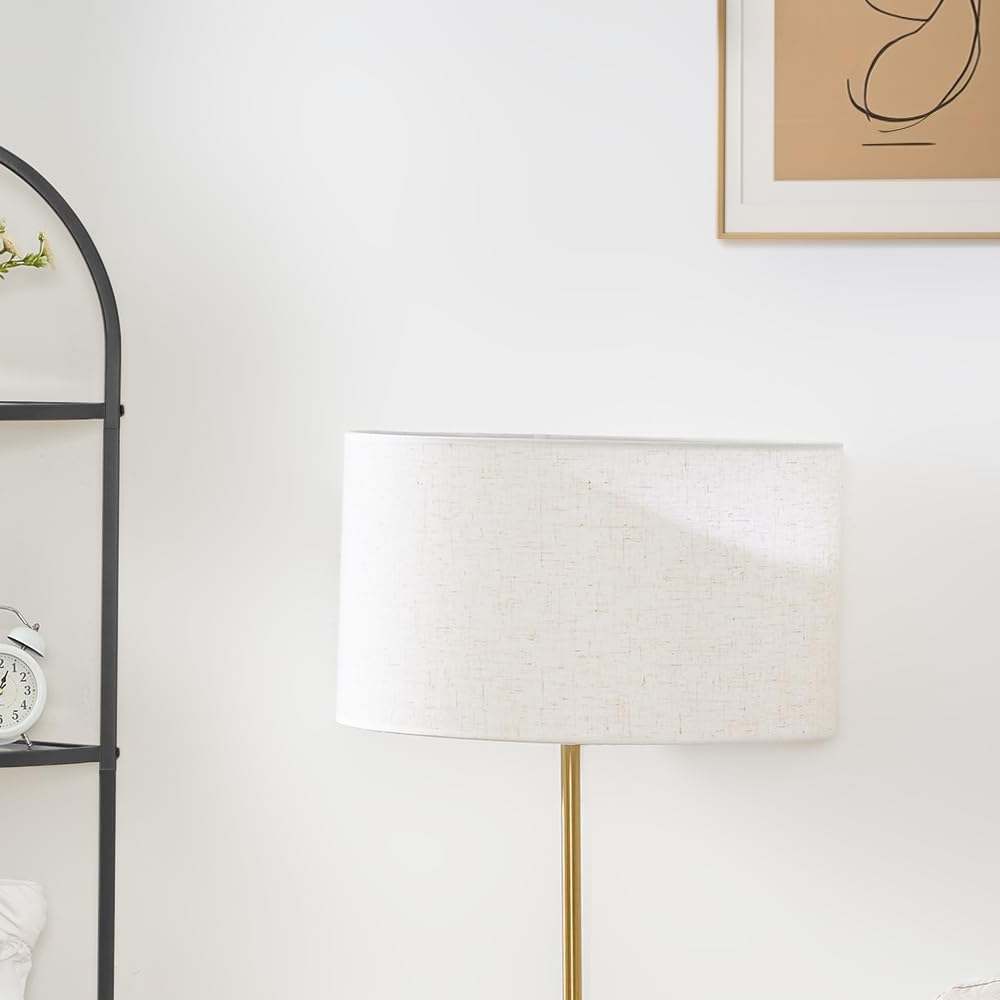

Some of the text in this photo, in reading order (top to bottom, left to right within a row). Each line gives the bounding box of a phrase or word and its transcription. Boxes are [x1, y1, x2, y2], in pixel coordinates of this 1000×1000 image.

[12, 663, 17, 672] 1
[20, 672, 27, 682] 2
[24, 686, 31, 695] 3
[20, 700, 27, 710] 4
[12, 710, 19, 720] 5
